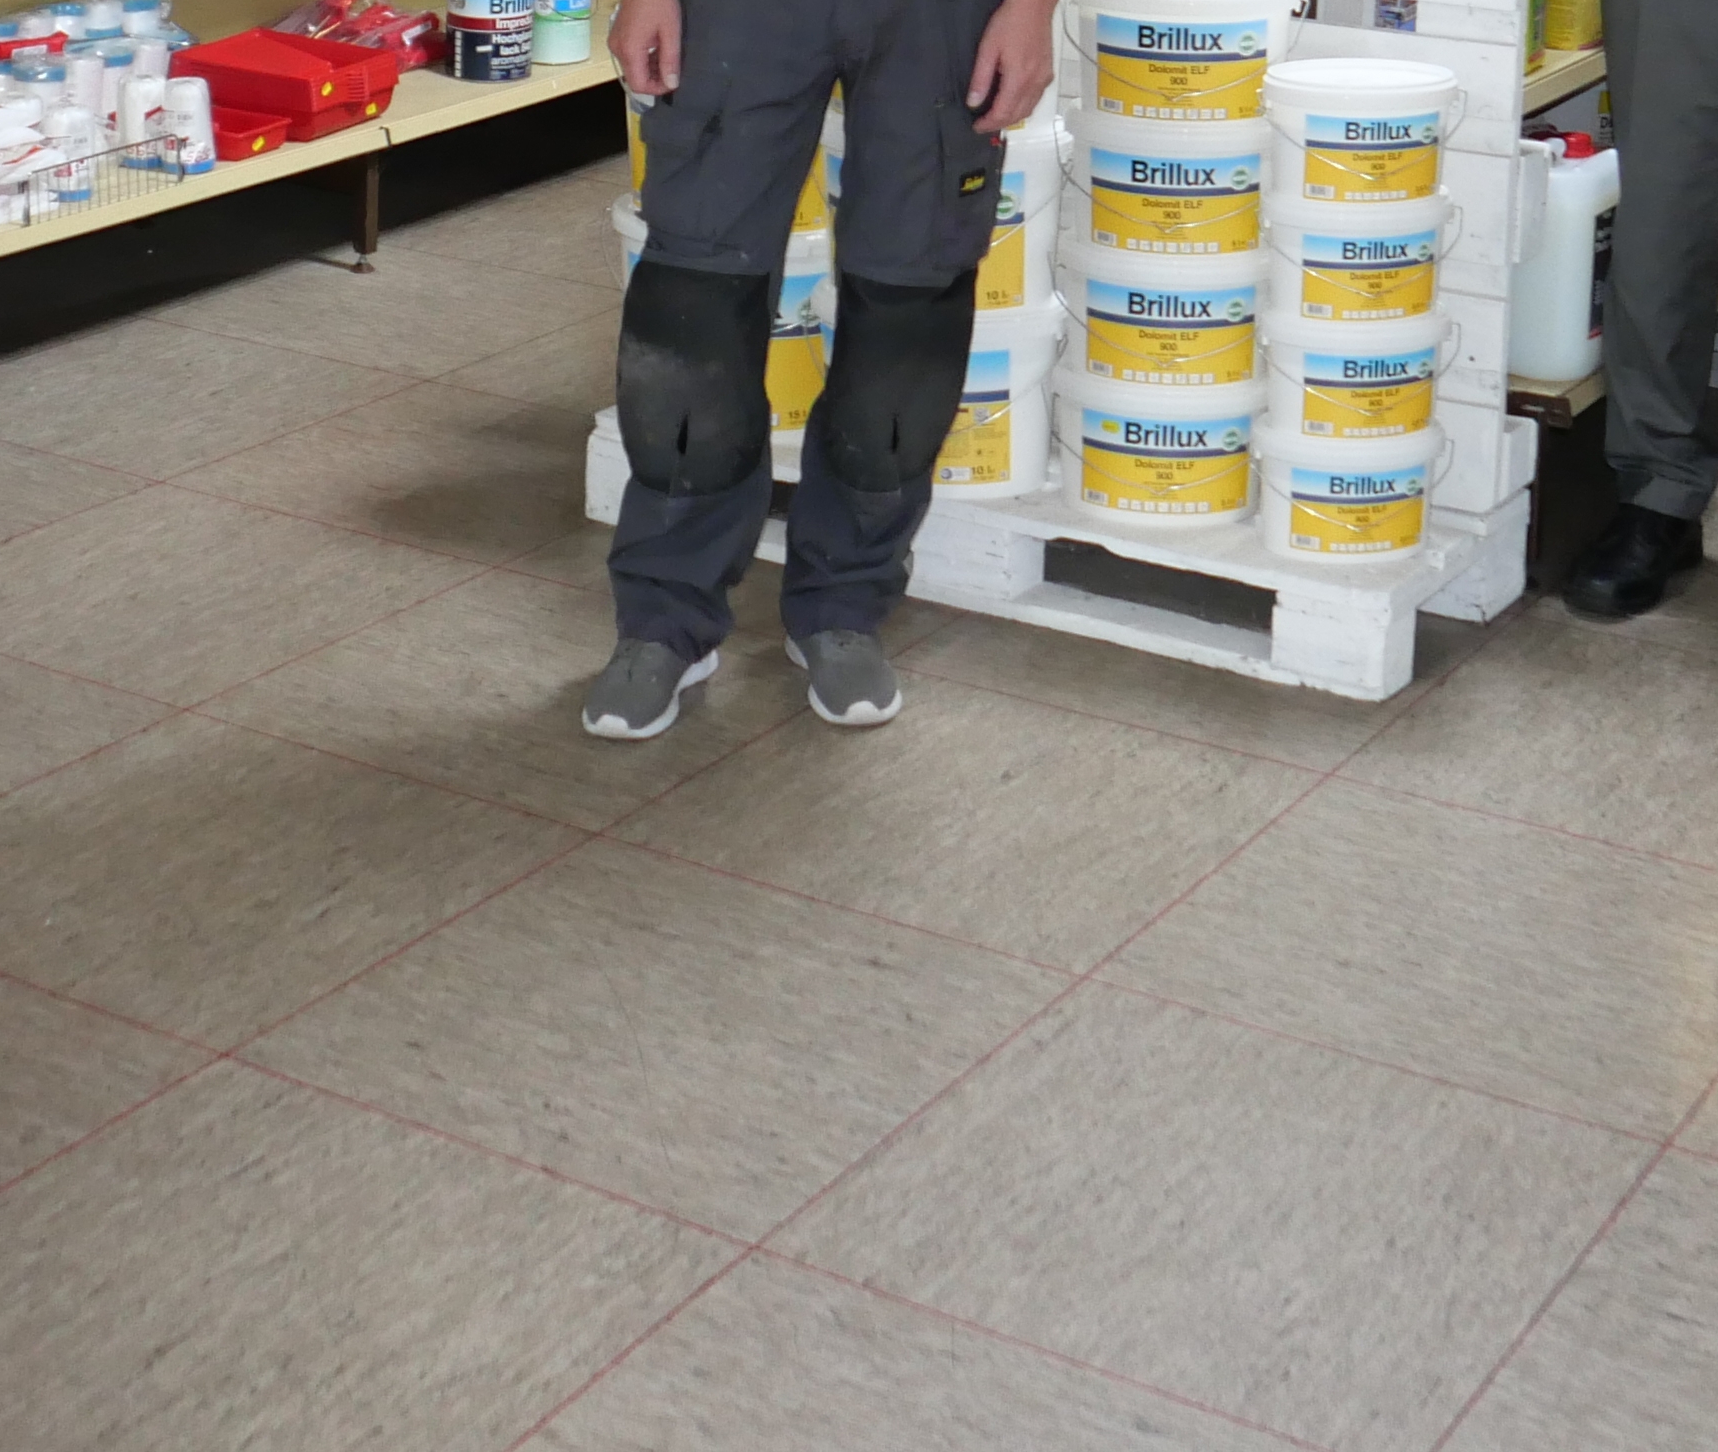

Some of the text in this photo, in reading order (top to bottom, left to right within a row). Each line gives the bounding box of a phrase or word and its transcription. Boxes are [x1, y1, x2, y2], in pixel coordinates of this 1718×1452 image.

[1138, 25, 1223, 51] Brillux
[1148, 63, 1211, 75] Dolomit ELF
[1345, 121, 1412, 141] Brillux
[1131, 159, 1216, 186] Brillux
[1142, 198, 1203, 209] Dolomit ELF
[1342, 241, 1408, 260] Brillux
[1127, 292, 1212, 318] Brillux
[1138, 330, 1200, 341] Dolomit ELF
[1343, 359, 1409, 379] Brillux
[1125, 421, 1208, 447] Brillux
[1135, 459, 1173, 470] Dolomit
[1329, 476, 1396, 495] Brillux
